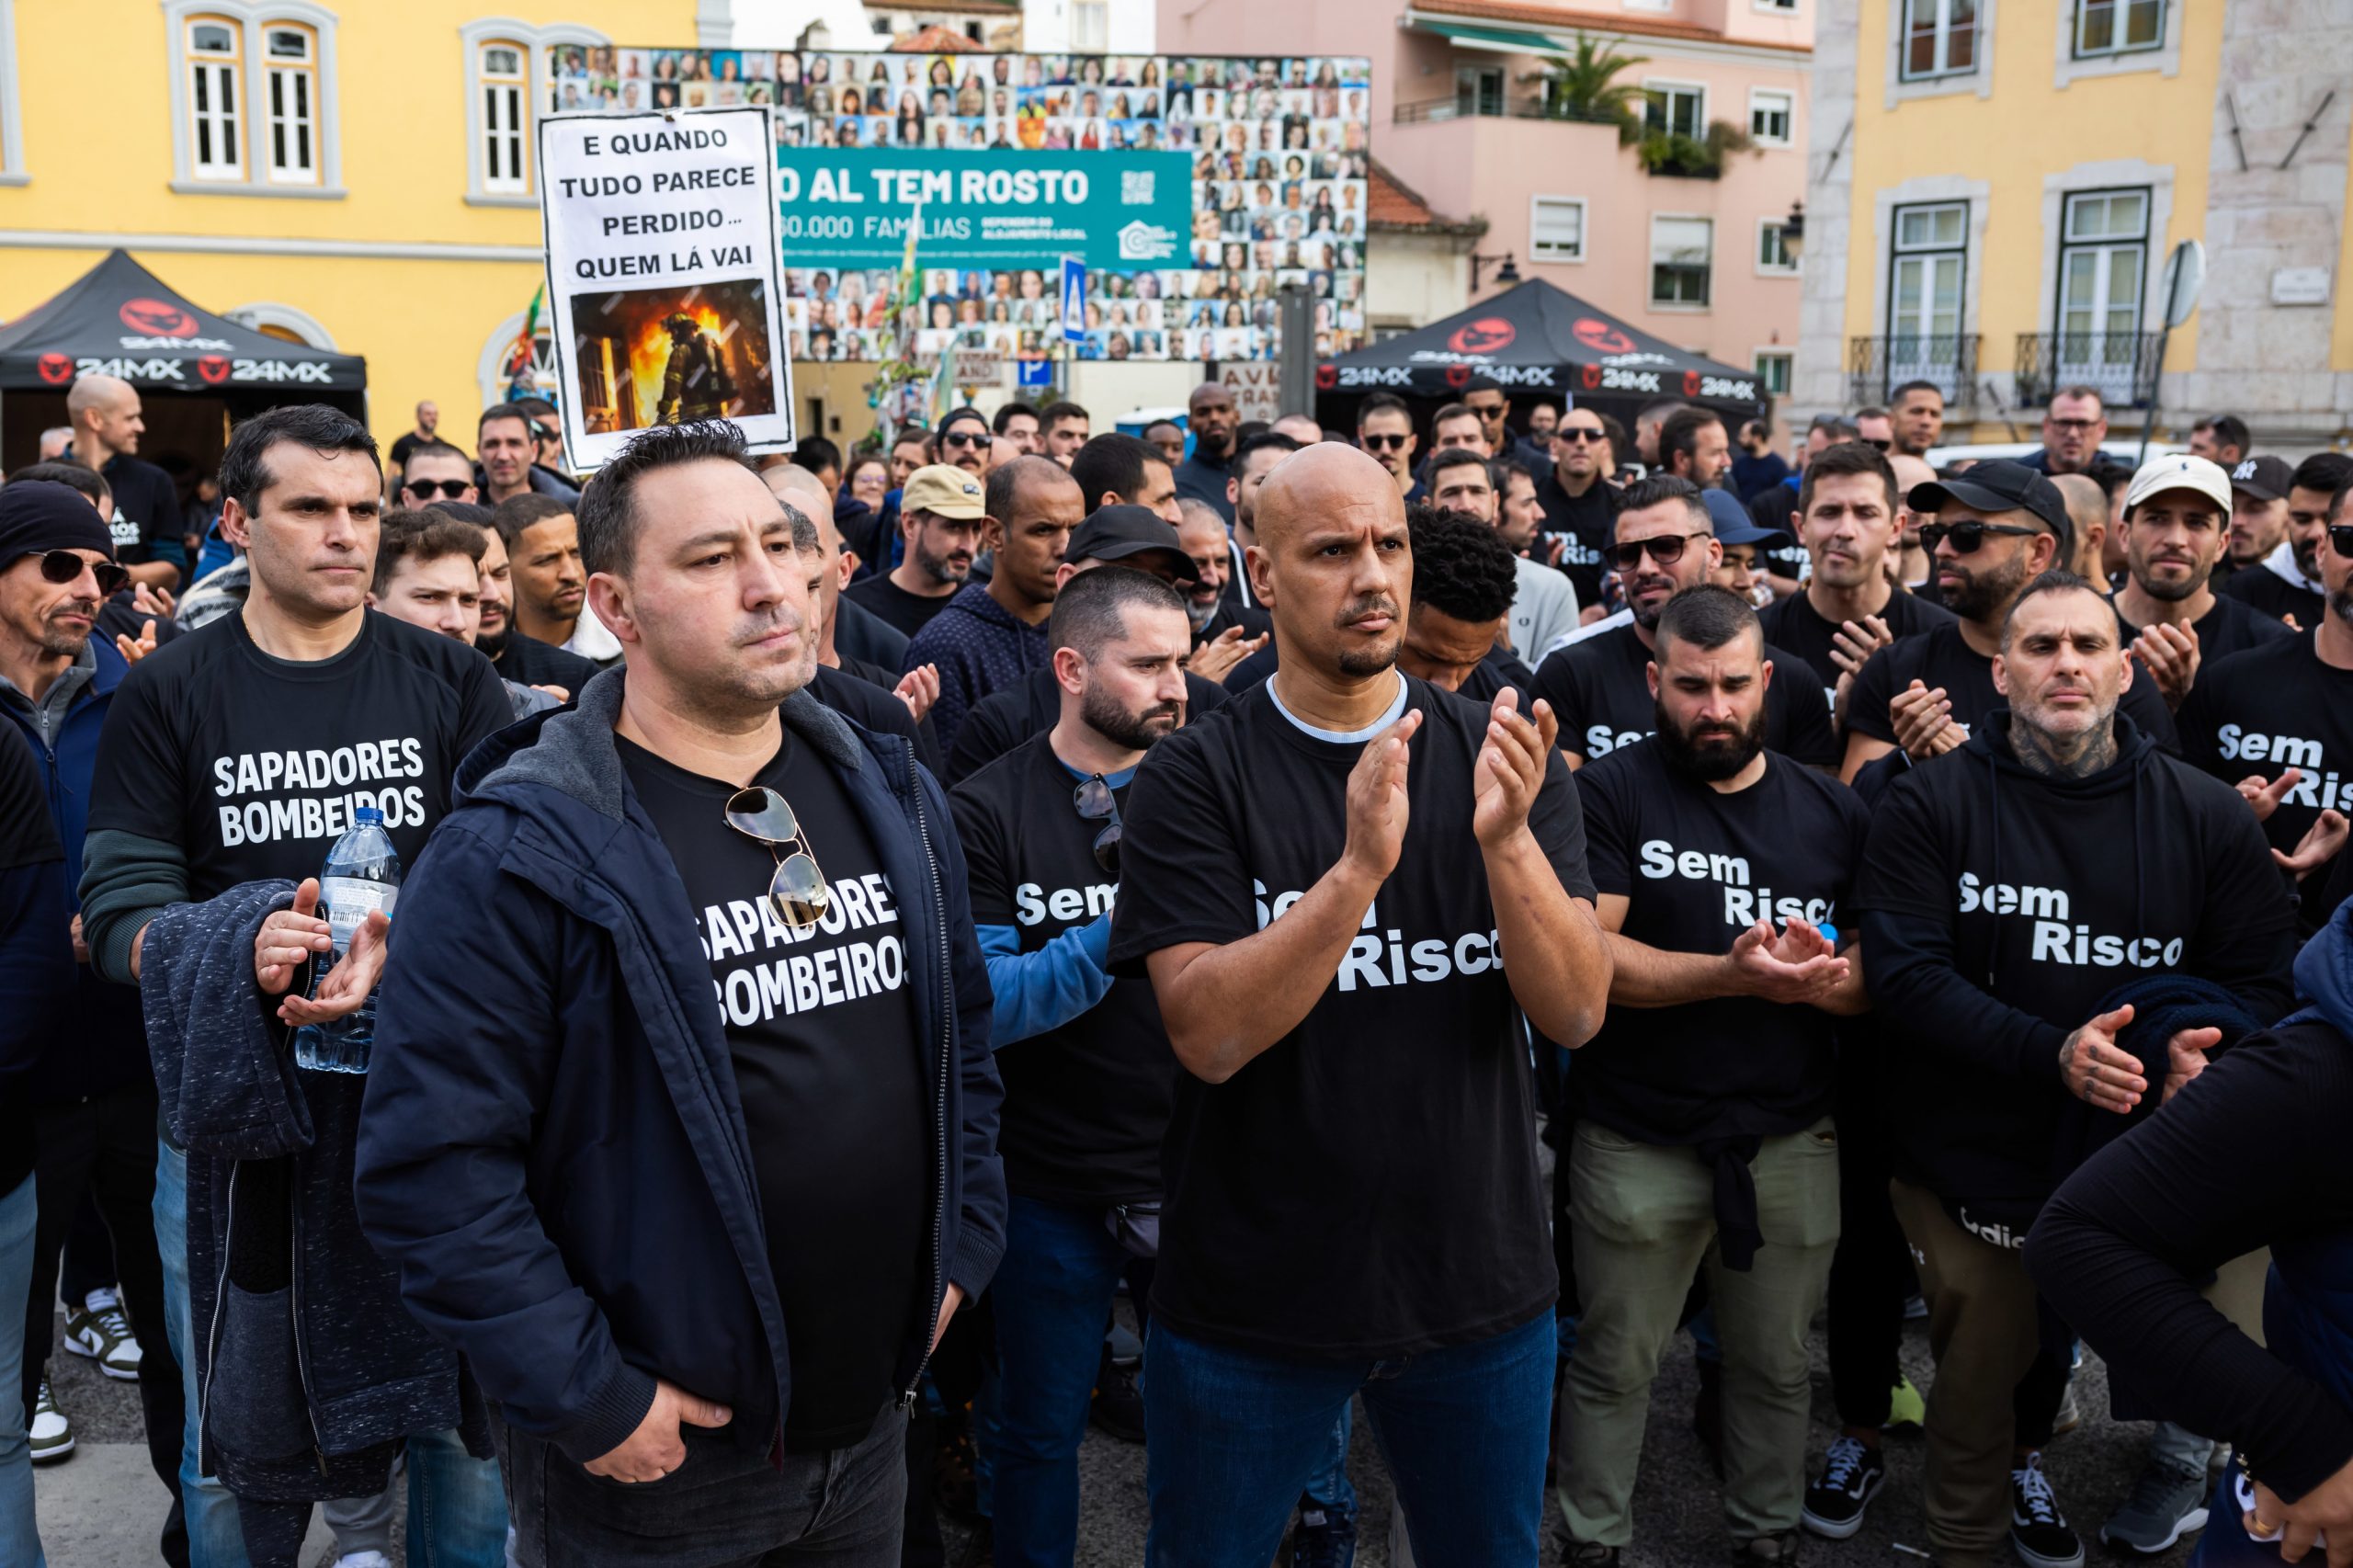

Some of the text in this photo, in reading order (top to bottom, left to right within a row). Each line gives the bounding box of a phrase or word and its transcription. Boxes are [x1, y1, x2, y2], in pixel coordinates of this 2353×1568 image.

[584, 129, 728, 155] E QUANDO
[560, 166, 756, 198] TUDO PARECE
[808, 167, 864, 203] AL
[870, 168, 952, 204] TEM
[961, 169, 1089, 204] ROSTO
[864, 217, 972, 240] FAMLIAS
[575, 245, 752, 279] QUEM LÁ VAI
[75, 358, 186, 381] 24MX
[232, 359, 334, 382] 24MX
[1339, 368, 1414, 386] 24MX
[1586, 724, 1655, 759] Se
[2218, 723, 2324, 768] Sem
[214, 737, 424, 798] SAPADORES
[1640, 839, 1750, 885] Sem
[1017, 882, 1120, 926] Sem
[1724, 886, 1835, 927] Risc
[1959, 872, 2069, 920] Sem
[2031, 920, 2183, 968] Risco
[713, 935, 911, 1027] OMBEIRO
